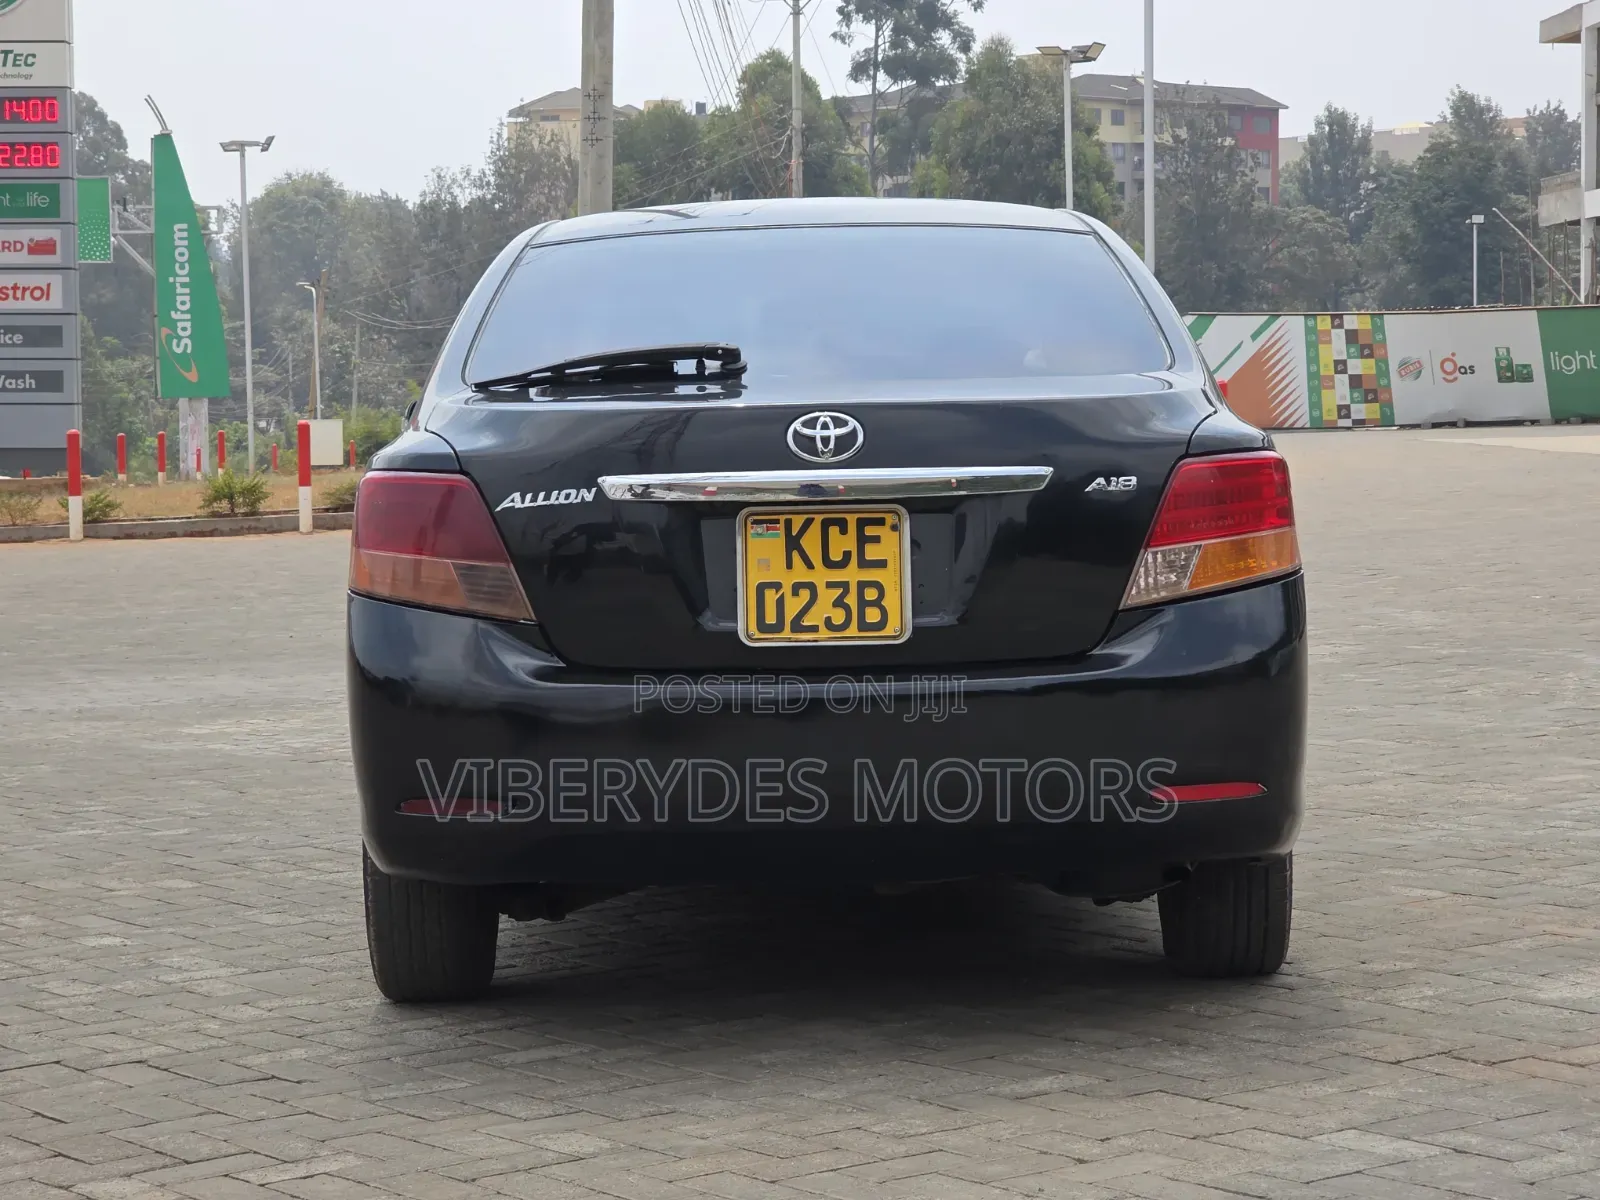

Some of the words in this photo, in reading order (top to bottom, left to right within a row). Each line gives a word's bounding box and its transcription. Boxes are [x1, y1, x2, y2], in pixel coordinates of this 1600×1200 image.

[26, 191, 50, 208] life
[0, 240, 25, 253] RD
[0, 282, 52, 302] strol
[168, 223, 193, 354] Safaricom
[0, 328, 24, 344] ice
[1440, 351, 1476, 384] gas
[1550, 350, 1598, 375] light
[1084, 475, 1137, 492] A18
[494, 487, 597, 512] ALLION
[783, 516, 888, 570] KCE
[755, 579, 889, 634] 023B
